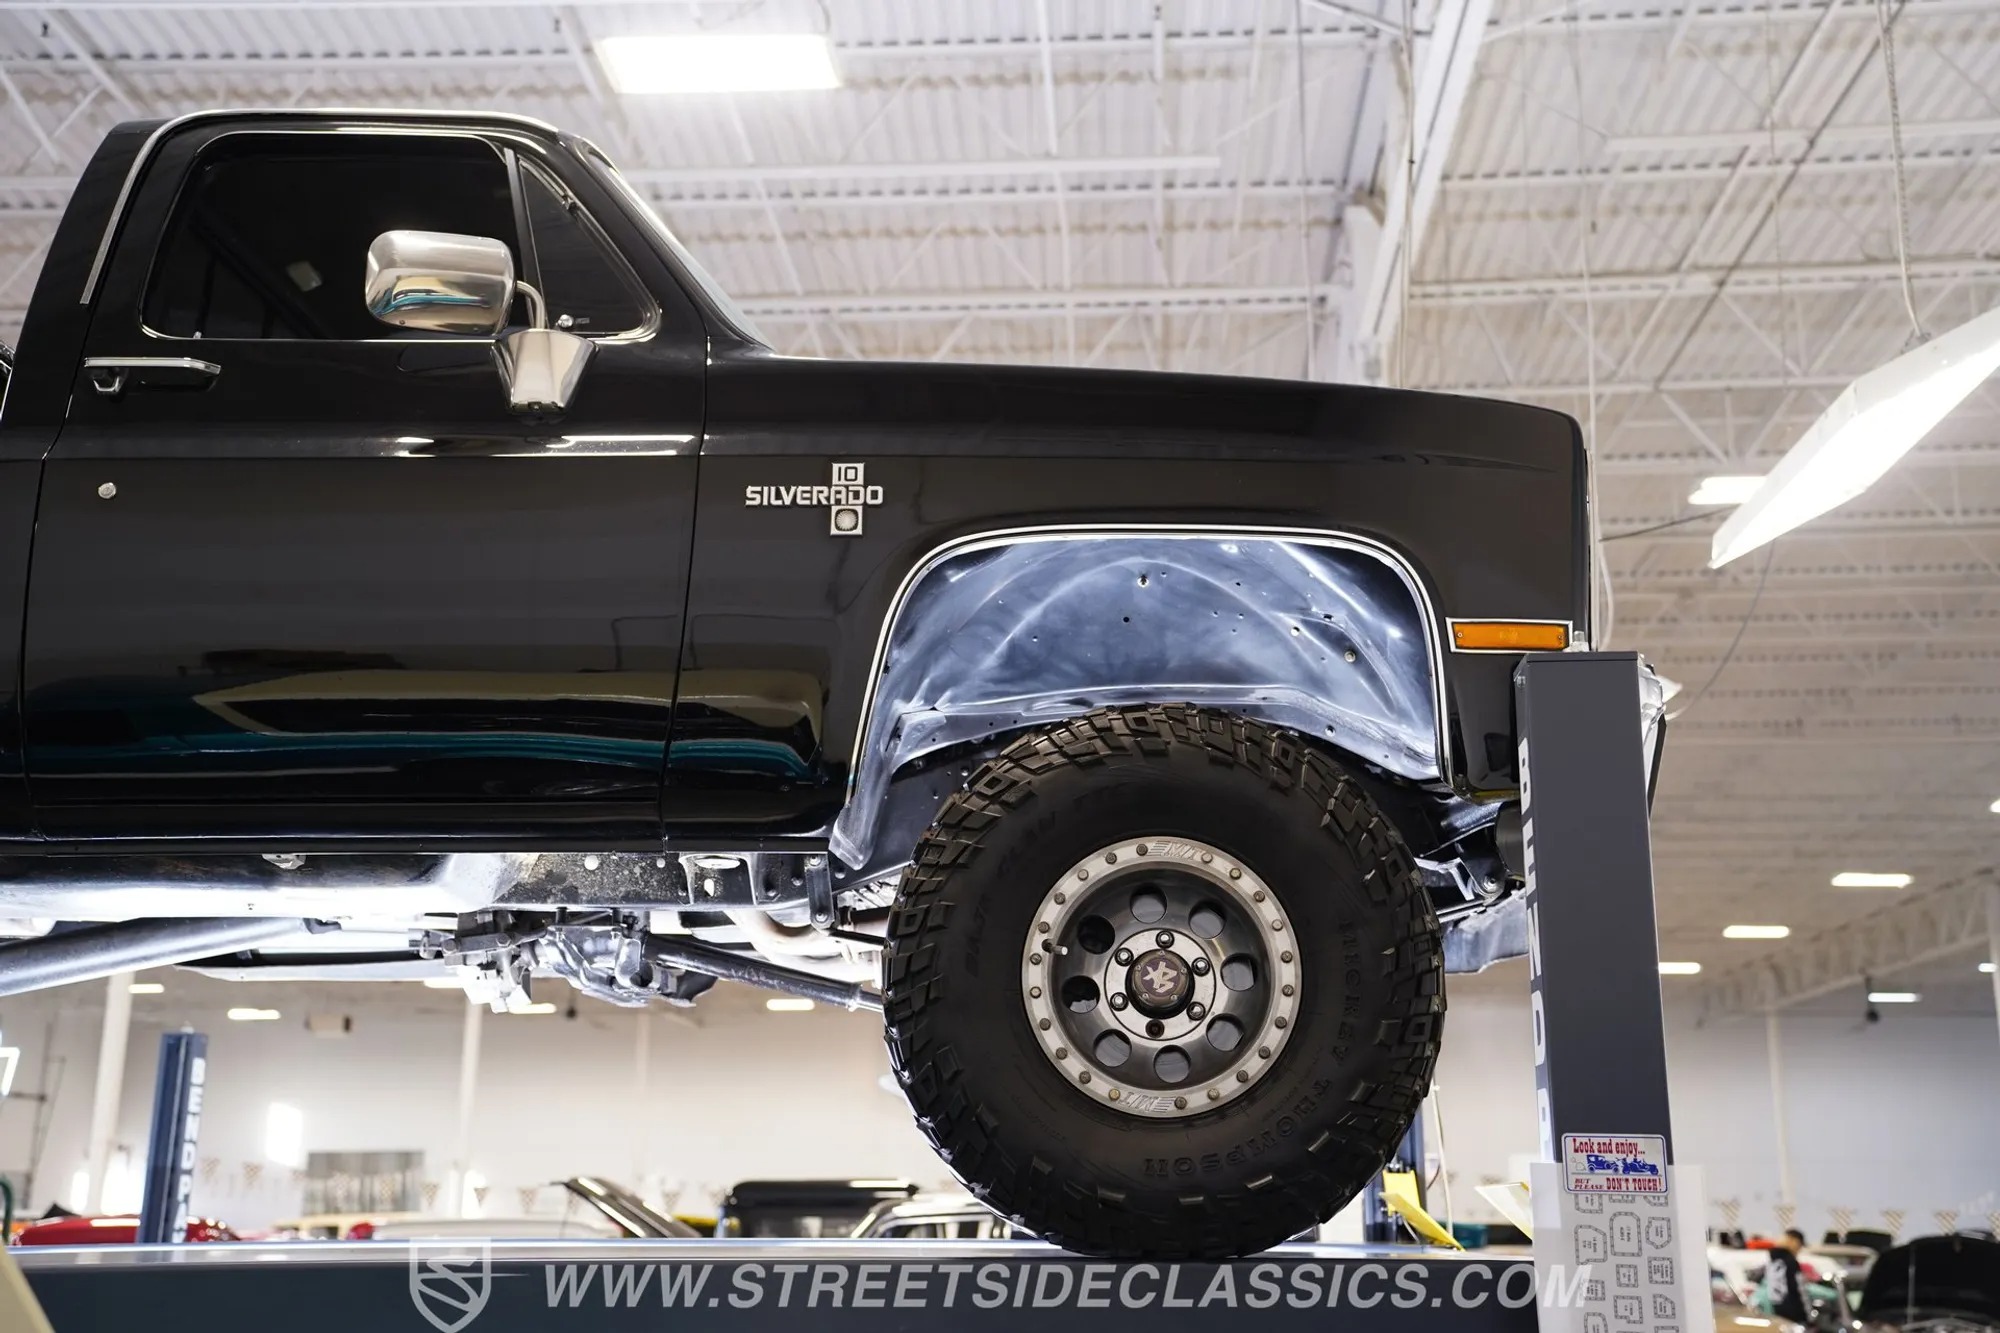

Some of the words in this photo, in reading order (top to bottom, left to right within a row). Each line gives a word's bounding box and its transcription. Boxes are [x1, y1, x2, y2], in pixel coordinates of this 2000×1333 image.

[837, 466, 858, 482] 10
[745, 485, 883, 506] SILVERADO
[1142, 1074, 1335, 1181] THOMPSON
[1572, 1137, 1595, 1154] Look
[1597, 1138, 1613, 1154] and
[1615, 1139, 1645, 1158] enjoy...
[1606, 1177, 1630, 1191] DON'T
[1632, 1178, 1662, 1191] TOUCH!
